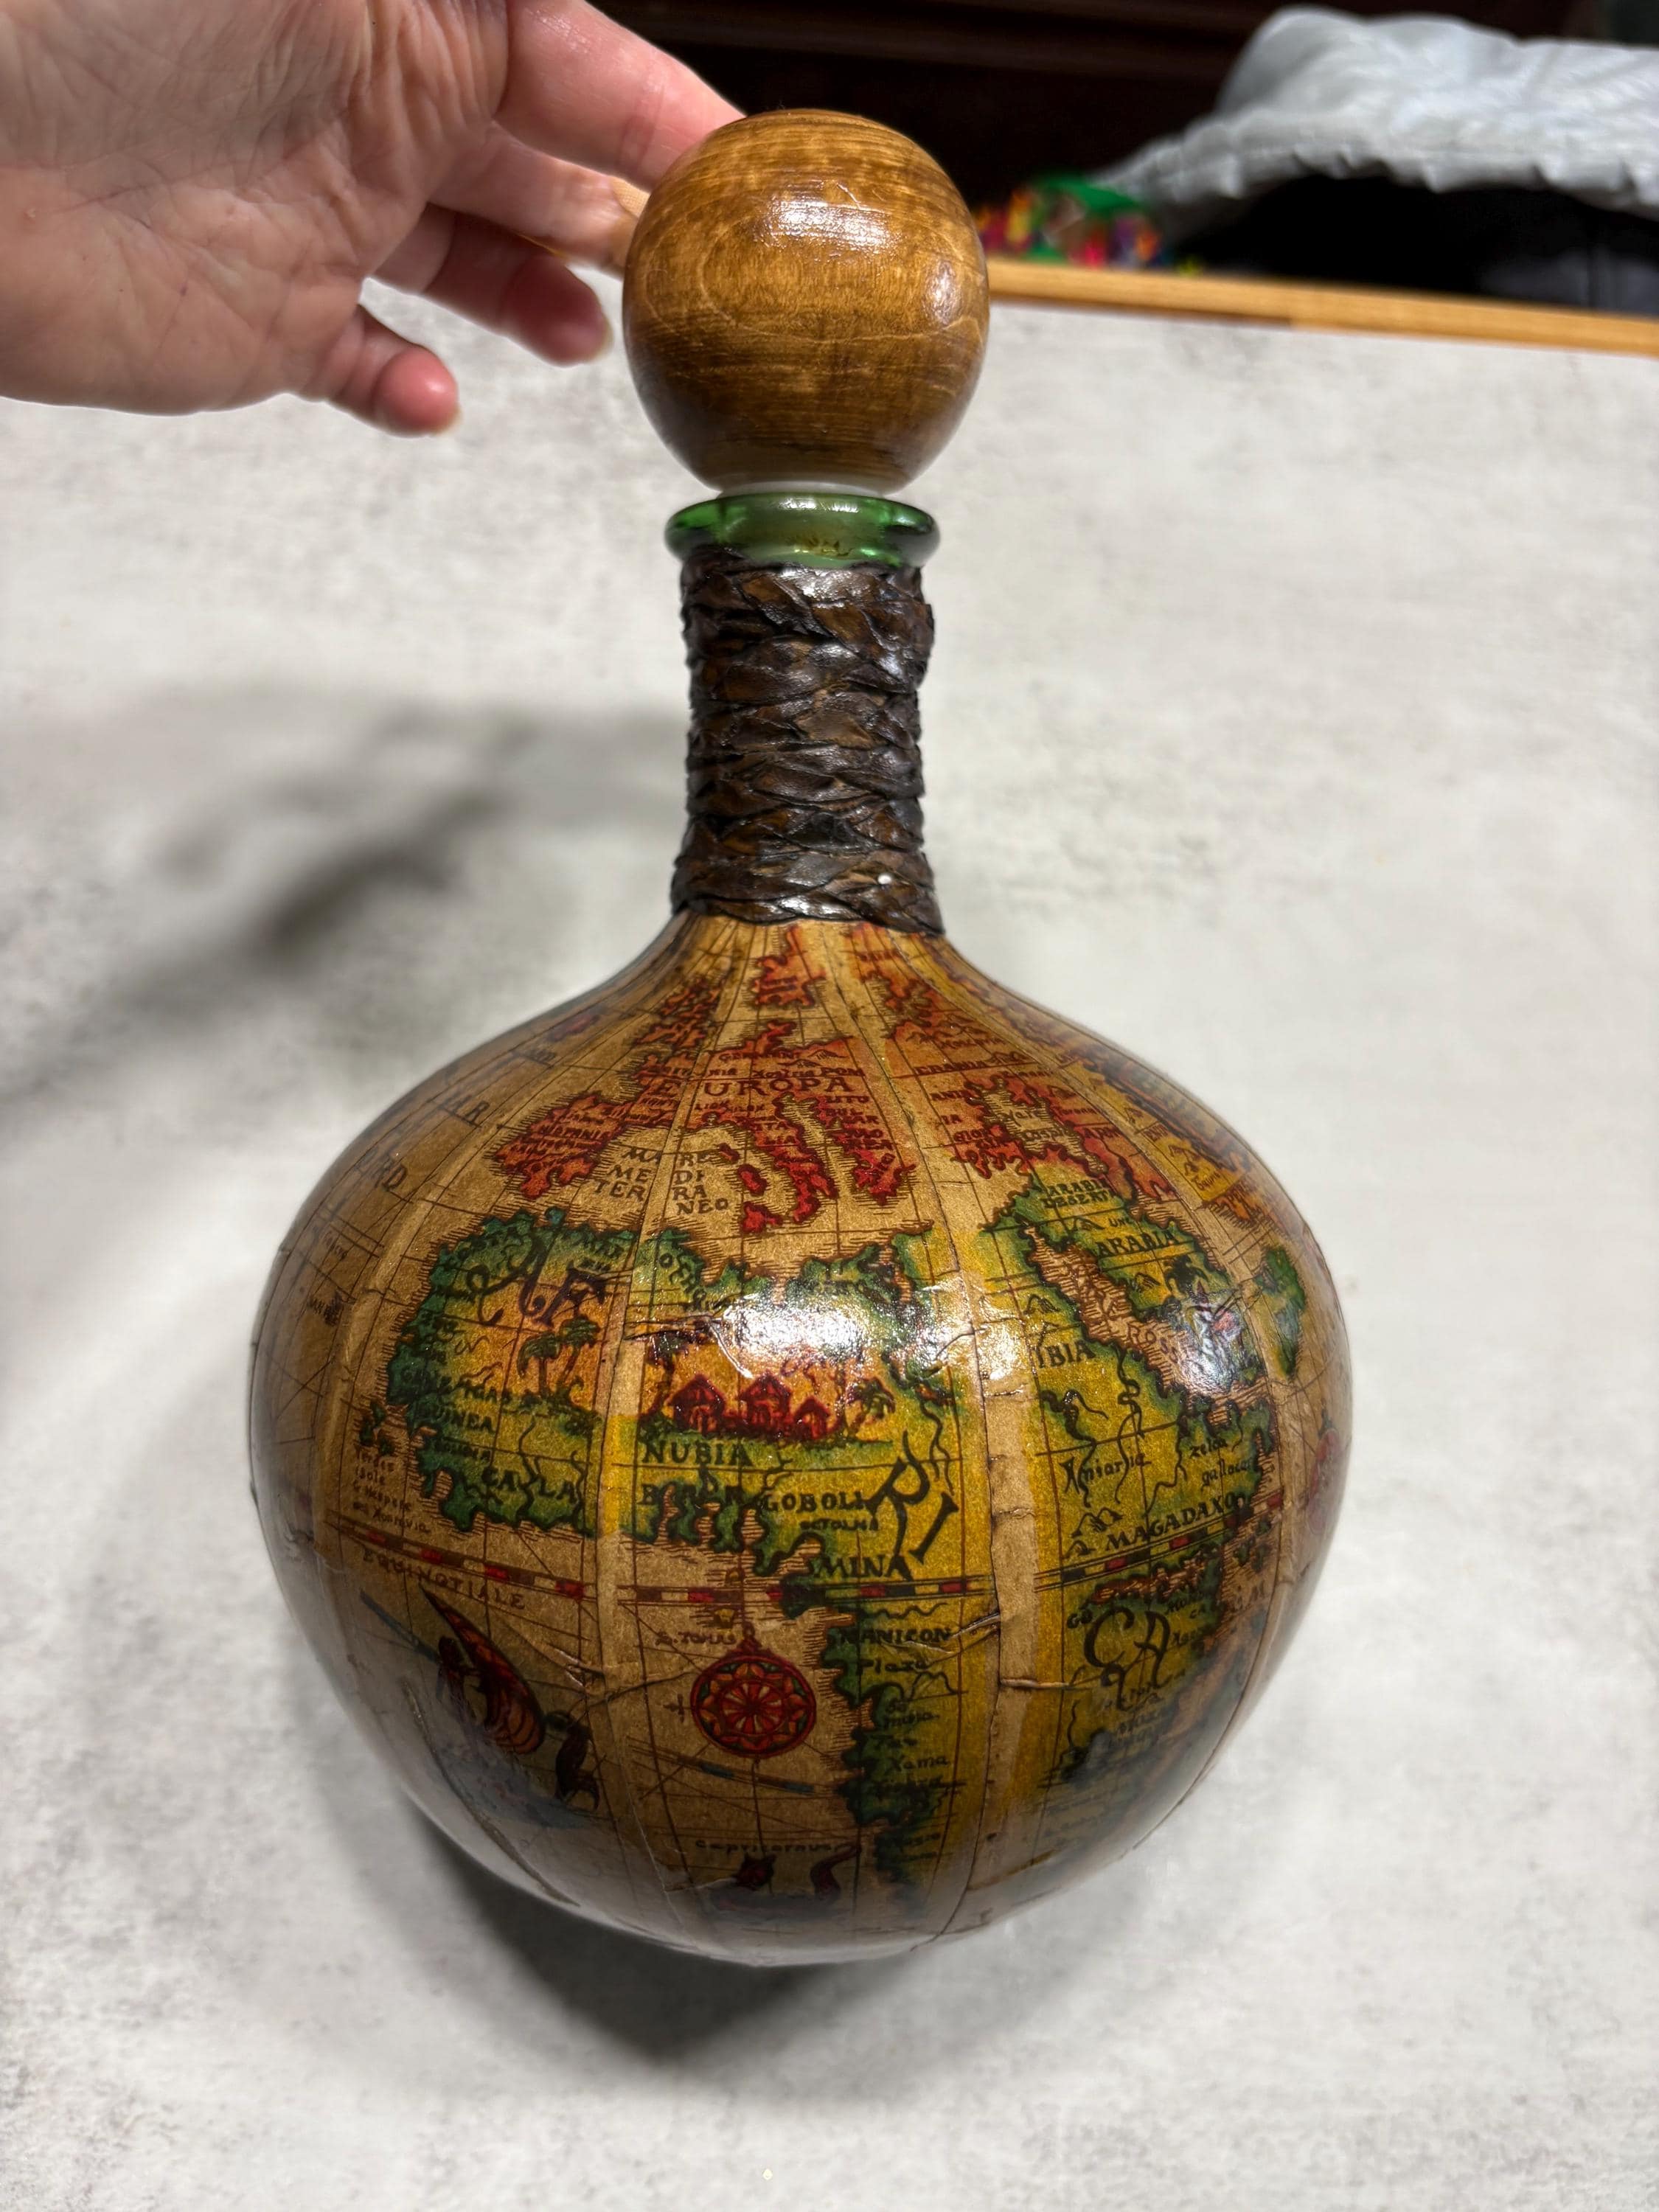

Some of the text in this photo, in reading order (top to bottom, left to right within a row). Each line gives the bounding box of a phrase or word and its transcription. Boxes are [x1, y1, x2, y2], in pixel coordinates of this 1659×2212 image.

[594, 1180, 708, 1202] TER RA
[676, 1197, 728, 1216] NEO
[641, 1439, 754, 1467] NUBIA
